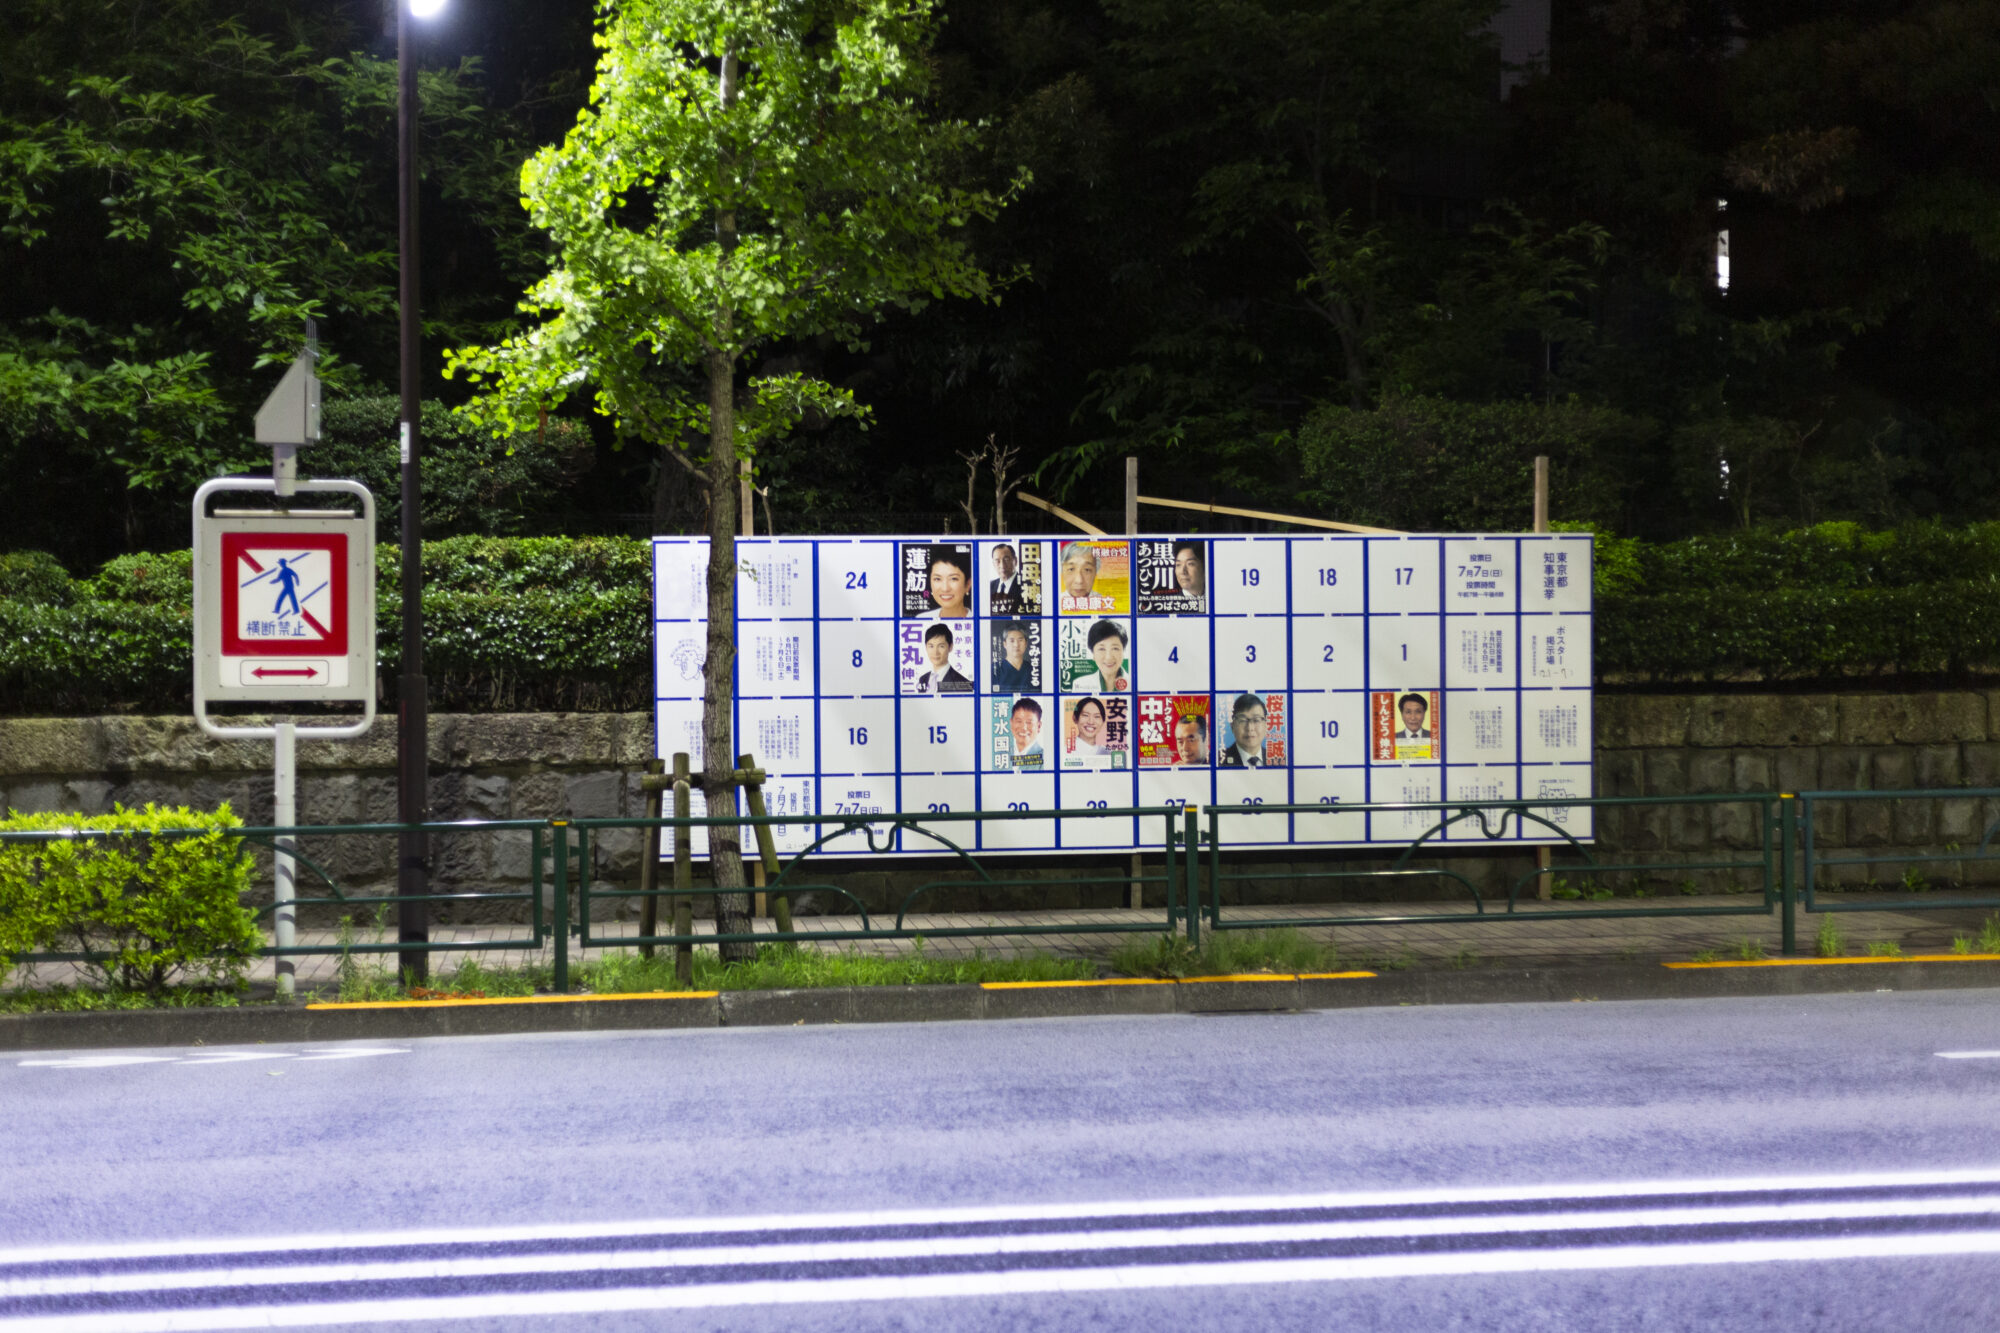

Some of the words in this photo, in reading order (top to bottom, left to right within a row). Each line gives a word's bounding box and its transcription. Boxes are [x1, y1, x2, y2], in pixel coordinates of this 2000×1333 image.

[905, 548, 927, 592] 蓮舫
[1021, 544, 1041, 604] 田母神
[1138, 542, 1152, 595] あつひこ
[1152, 543, 1175, 590] 黒川
[1557, 552, 1568, 587] 東京都
[846, 571, 867, 589] 24
[1241, 569, 1260, 586] 19
[1319, 569, 1337, 586] 18
[1395, 568, 1414, 585] 17
[1544, 552, 1555, 600] 知事選挙
[1154, 601, 1198, 612] つばさの党
[246, 620, 306, 636] 横断禁止
[1029, 622, 1040, 686] うつみさとる
[1168, 646, 1179, 663] 4
[1246, 645, 1256, 663] 3
[1323, 645, 1334, 662] 2
[1401, 644, 1407, 661] 1
[1556, 626, 1566, 665] ポスター
[852, 650, 863, 667] 8
[901, 624, 923, 692] 石丸伸二
[1106, 698, 1129, 743] 安野
[1140, 697, 1164, 744] 中松
[1320, 721, 1339, 738] 10
[849, 727, 868, 745] 16
[928, 726, 948, 744] 15
[994, 701, 1010, 769] 清水国明
[847, 791, 871, 799] 投票日
